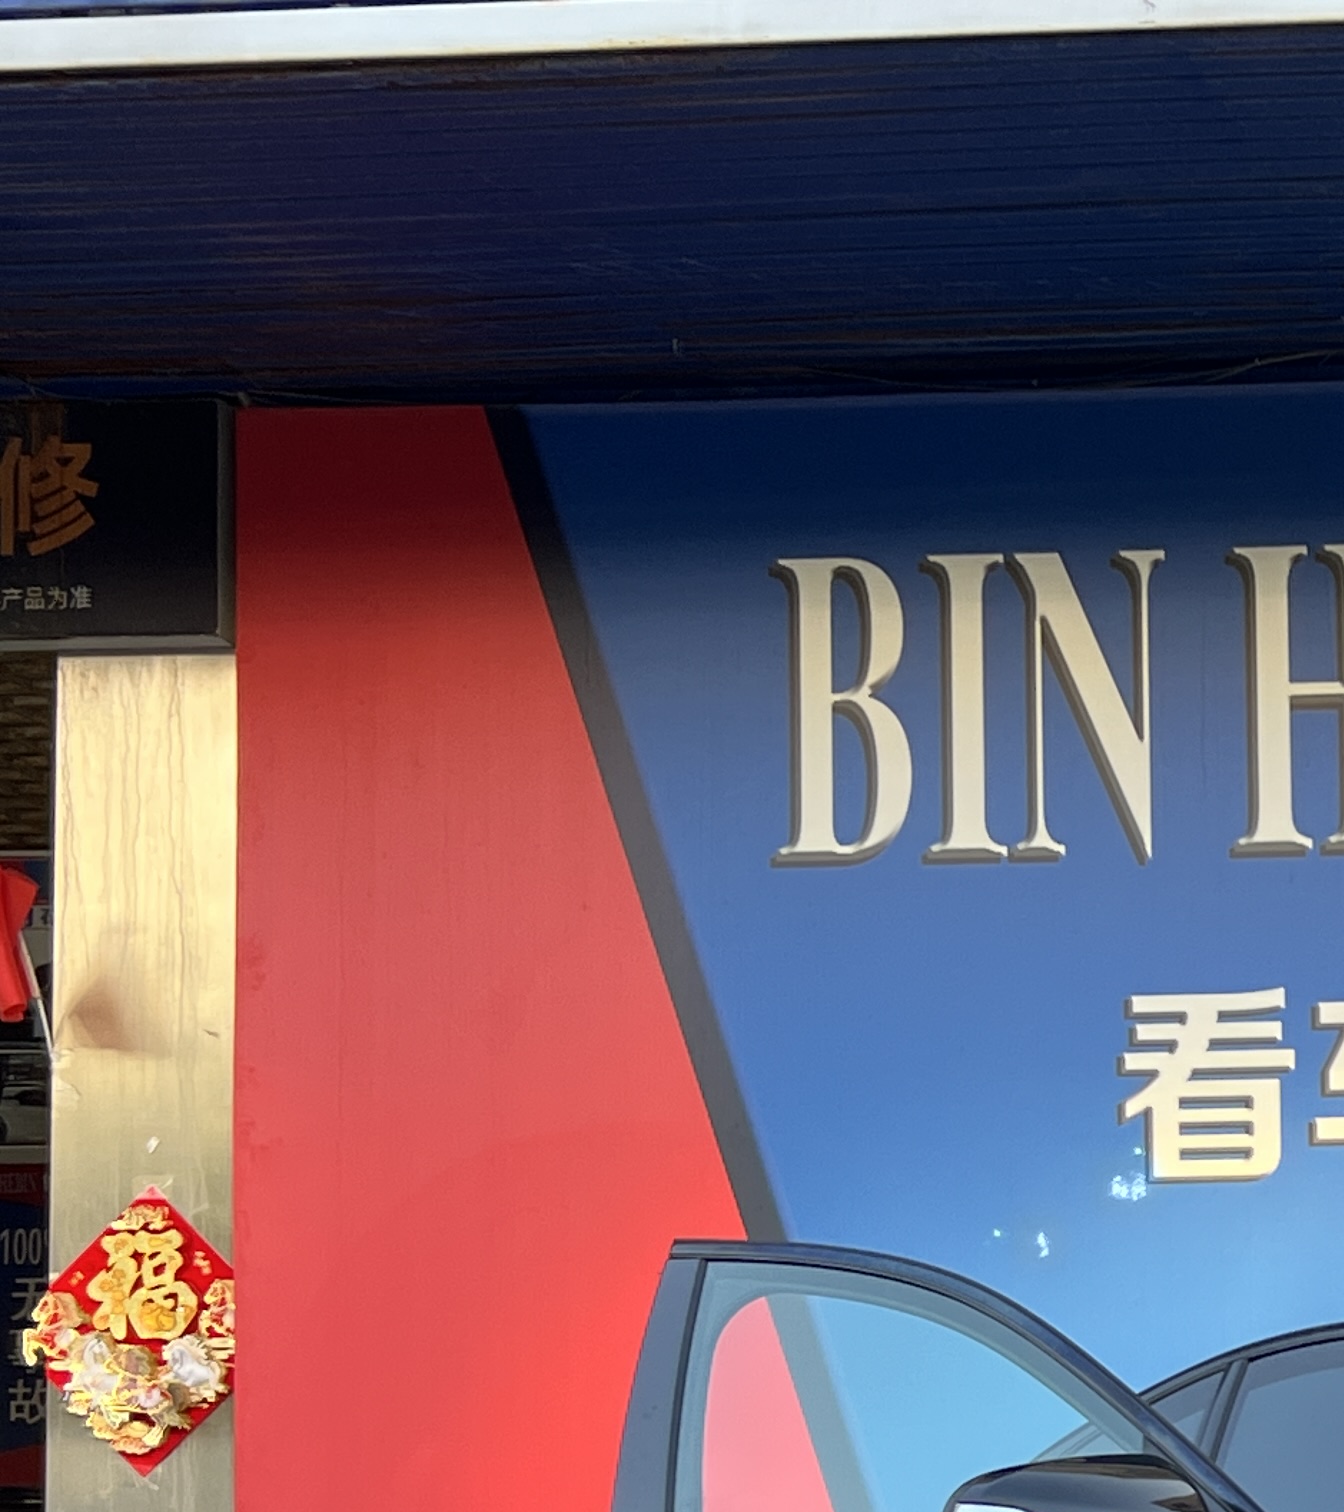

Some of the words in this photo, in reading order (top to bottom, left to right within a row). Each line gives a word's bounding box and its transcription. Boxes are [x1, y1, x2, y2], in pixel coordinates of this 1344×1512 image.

[0, 435, 99, 556] 修
[1, 586, 92, 610] 产品为准
[769, 549, 1166, 867] BIN
[0, 1228, 49, 1267] 100
[86, 1229, 199, 1340] 福
